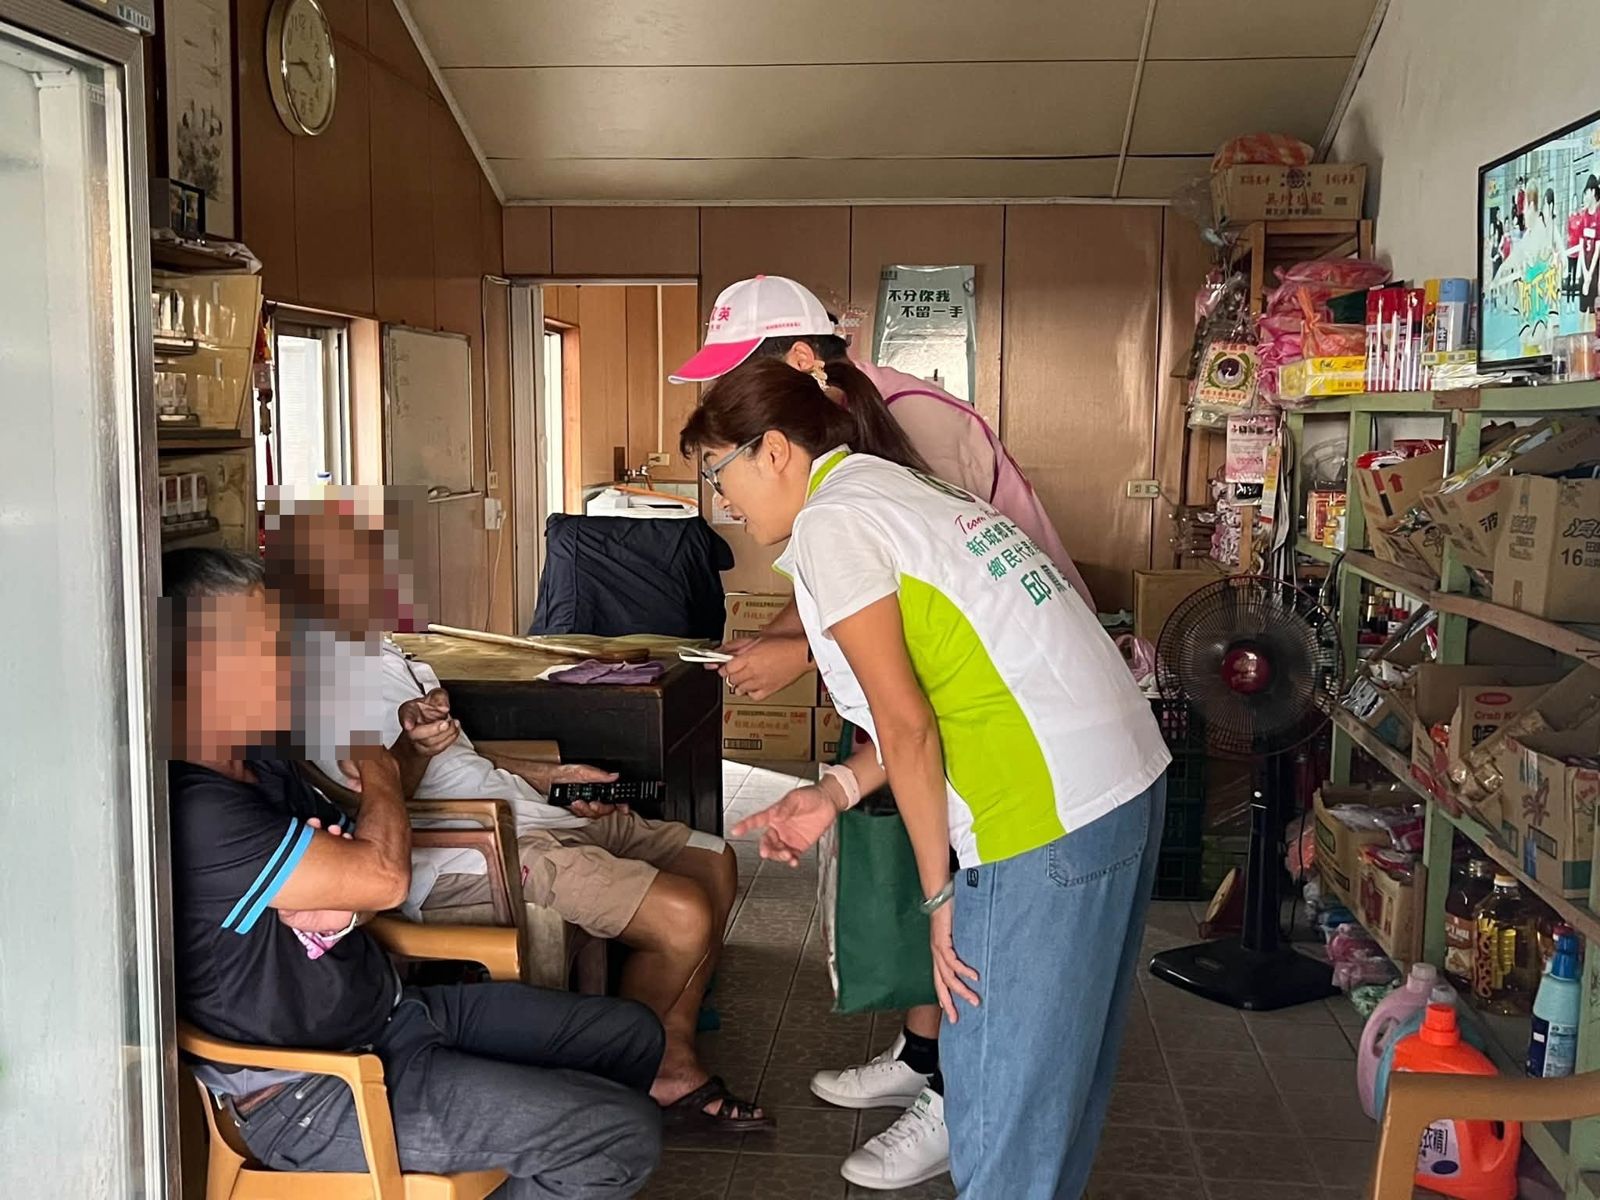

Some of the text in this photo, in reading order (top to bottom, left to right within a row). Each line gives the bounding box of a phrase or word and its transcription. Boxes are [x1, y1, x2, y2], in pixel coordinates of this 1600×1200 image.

[888, 289, 951, 303] 不分你我
[901, 305, 964, 319] 不留一手
[954, 514, 986, 536] Team
[1563, 517, 1600, 540] 浪
[1561, 548, 1584, 567] 16
